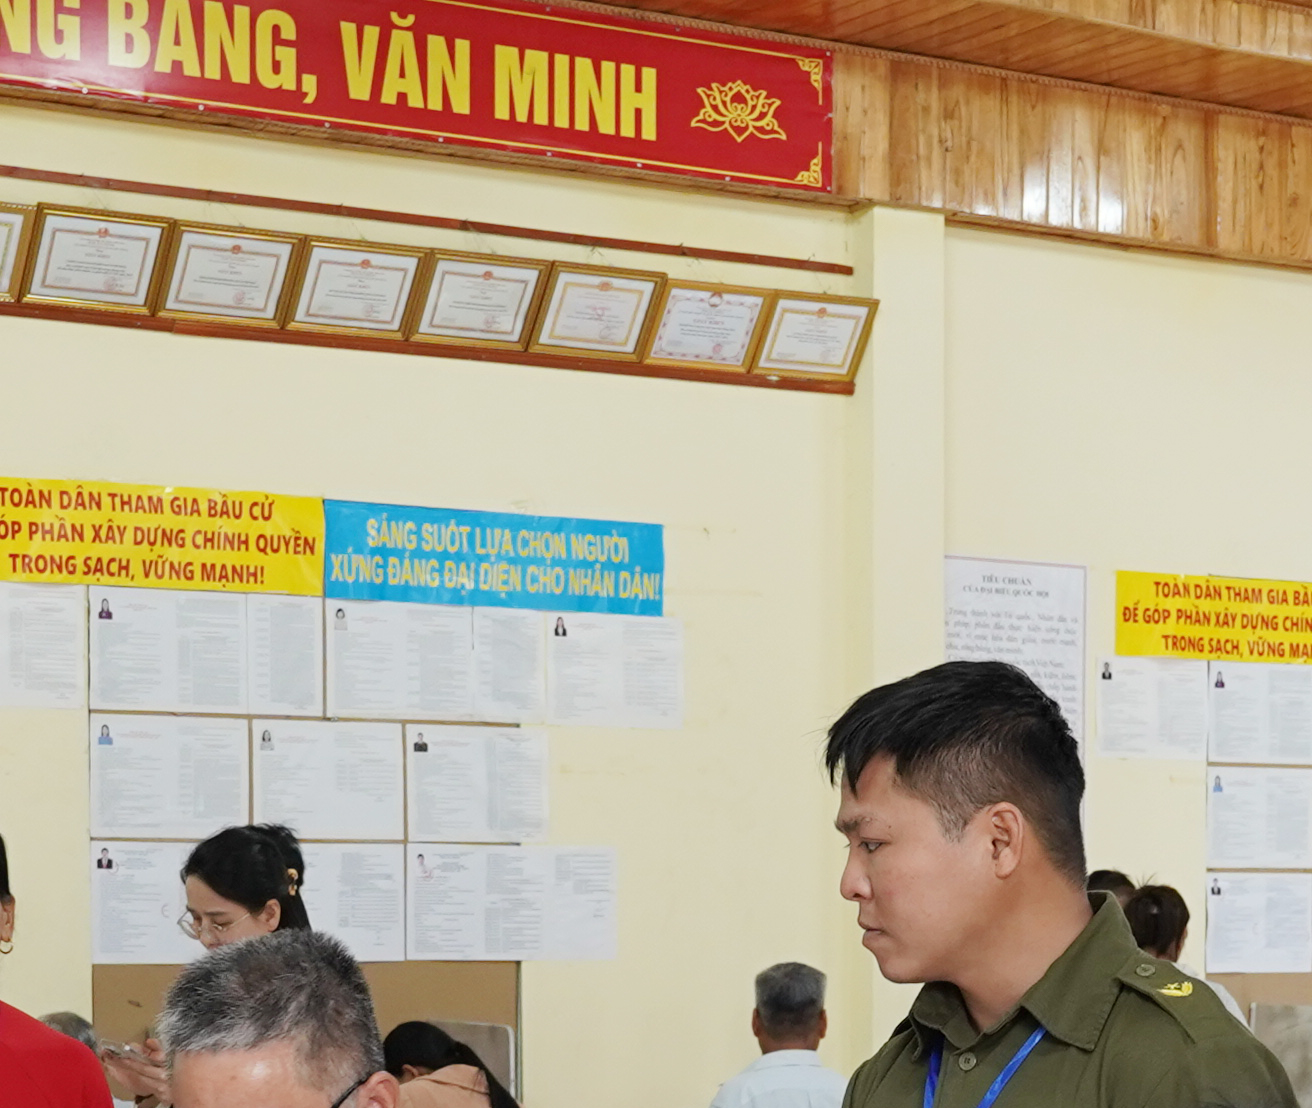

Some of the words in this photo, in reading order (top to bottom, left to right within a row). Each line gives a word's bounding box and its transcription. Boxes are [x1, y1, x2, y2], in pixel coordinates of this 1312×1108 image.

[340, 14, 471, 116] VĂN
[494, 44, 657, 141] MINH
[59, 485, 102, 511] DÂN
[107, 492, 163, 515] THAM
[170, 496, 202, 517] GIA
[208, 493, 243, 520] BẦU
[249, 494, 274, 521] CỬ
[29, 513, 84, 544] PHẦN
[91, 519, 126, 544] XÂY
[133, 525, 185, 551] DỰNG
[192, 526, 249, 552] CHÍNH
[255, 528, 316, 556] QUYỀN
[367, 513, 417, 550] SÁNG
[421, 519, 470, 552] SUỐT
[475, 526, 512, 561] LỰA
[517, 530, 567, 565] CHỌN
[572, 529, 629, 564] NGƯỜI
[9, 553, 76, 575] TRONG
[83, 557, 135, 585] SẠCH,
[141, 554, 194, 582] VỮNG
[201, 564, 264, 587] MẠNH!
[331, 547, 383, 583] XỨNG
[388, 549, 438, 587] ĐÁNG
[444, 563, 474, 595] ĐẠI
[482, 563, 520, 598] DIỆN
[525, 569, 564, 594] CHO
[569, 565, 615, 597] NHÂN
[619, 566, 660, 600] DÂN!
[1154, 577, 1190, 598] TOÀN
[1195, 579, 1222, 601] DÂN
[1226, 586, 1262, 604] THAM
[1267, 589, 1288, 605] GIA
[1122, 600, 1139, 624] ĐỂ
[1143, 601, 1171, 626] GÓP
[1176, 604, 1211, 628] PHẦN
[1214, 608, 1237, 629] XÂY
[1241, 613, 1278, 634] DỰNG
[1162, 634, 1204, 653] TRONG
[1208, 638, 1243, 658] SẠCH,
[1248, 636, 1285, 659] VỮNG
